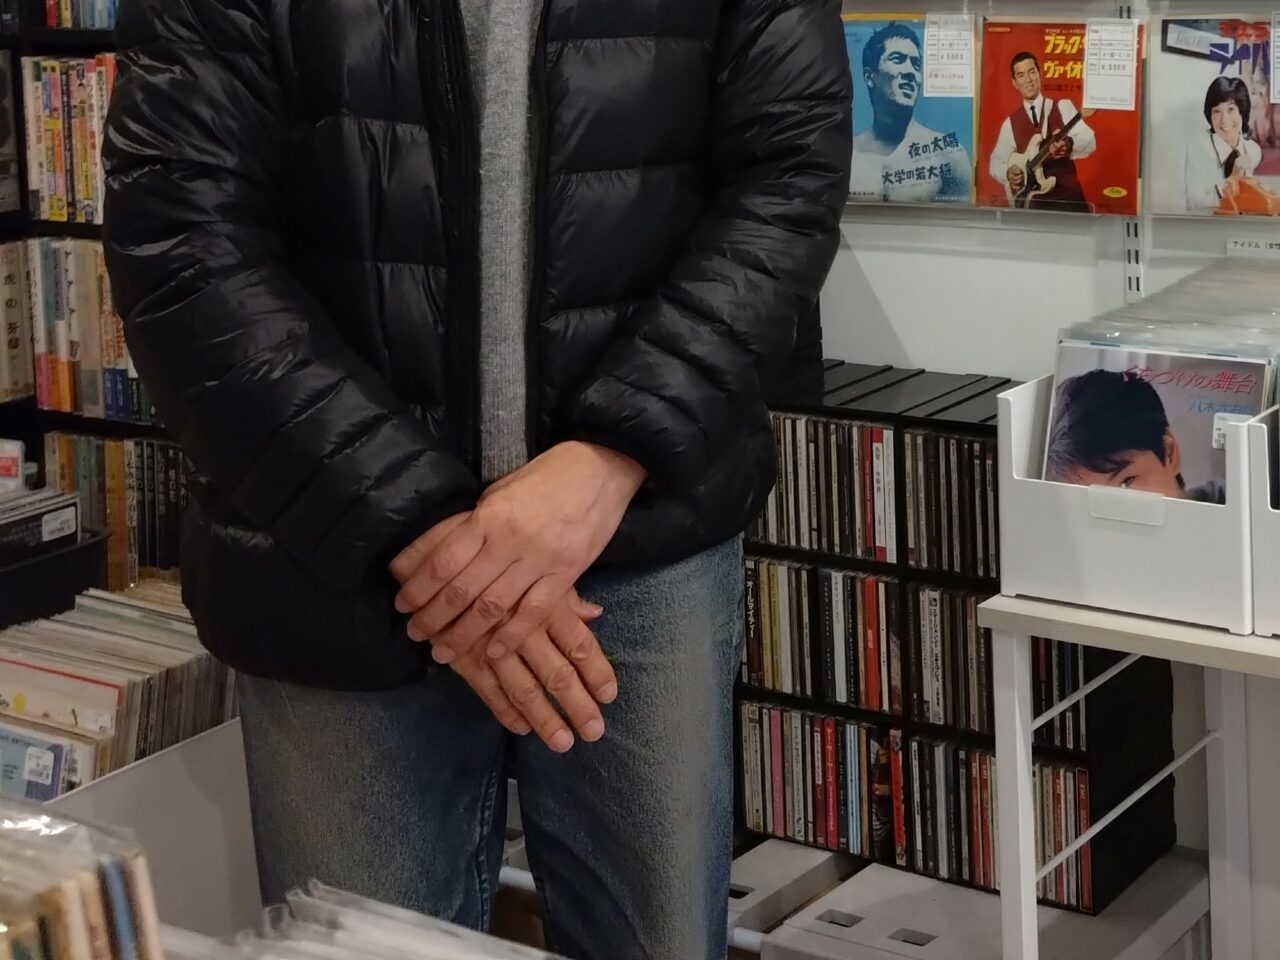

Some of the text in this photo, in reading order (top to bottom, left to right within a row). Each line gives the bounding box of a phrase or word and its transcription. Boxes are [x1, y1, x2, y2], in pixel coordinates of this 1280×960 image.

[908, 132, 960, 159] 夜の太陽
[882, 161, 952, 185] 大学の若大将
